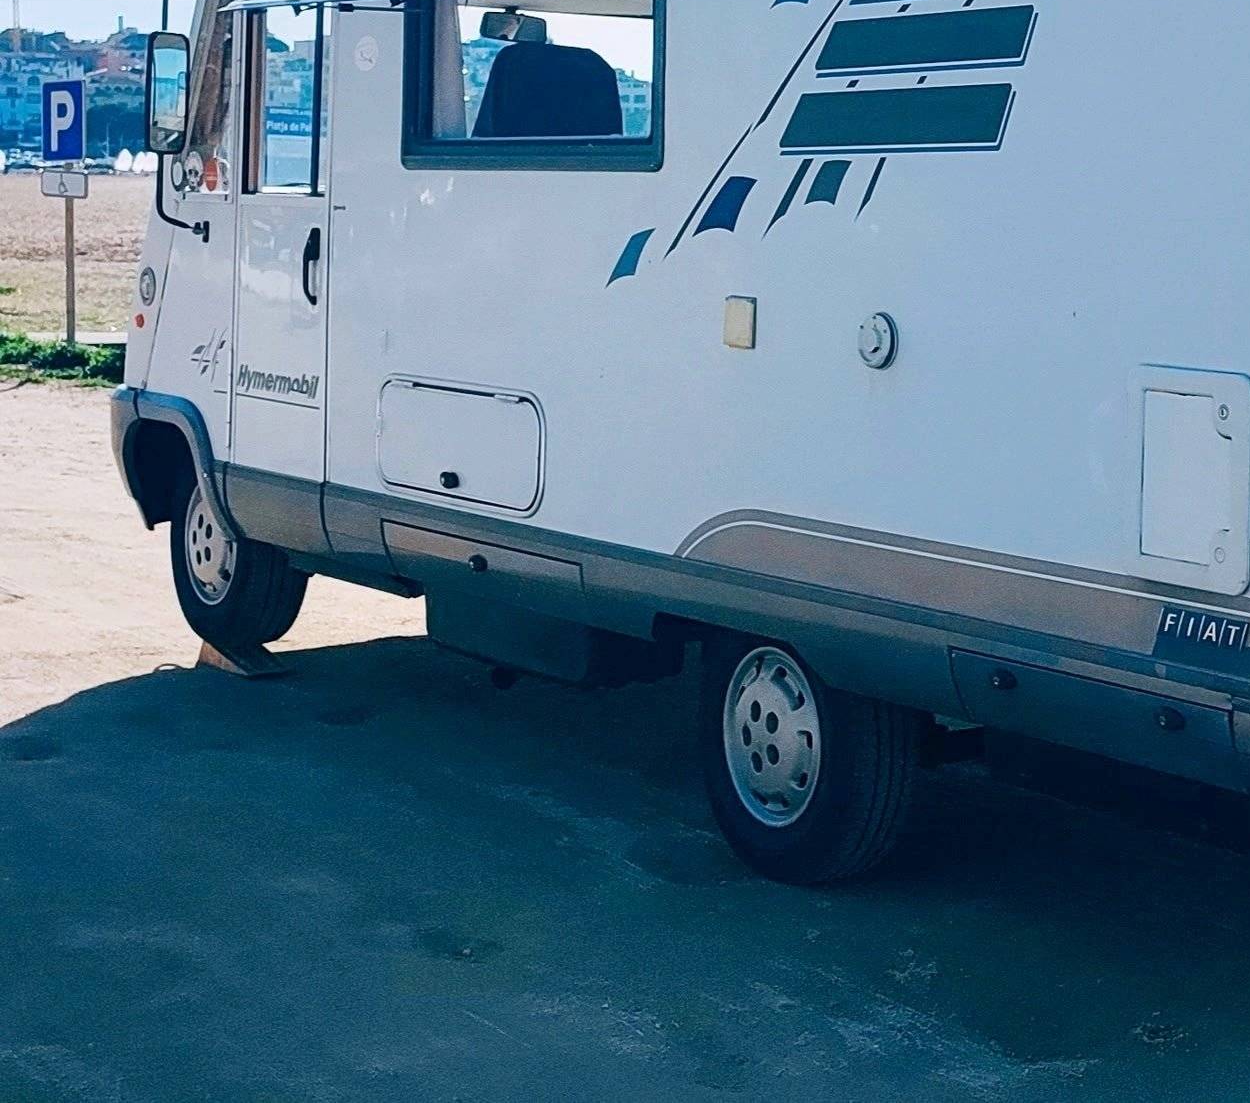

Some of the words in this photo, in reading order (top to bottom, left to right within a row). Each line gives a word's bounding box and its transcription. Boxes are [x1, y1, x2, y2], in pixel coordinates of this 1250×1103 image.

[51, 90, 75, 152] P
[237, 364, 320, 399] Hymermobil
[1163, 613, 1241, 646] FIAT
